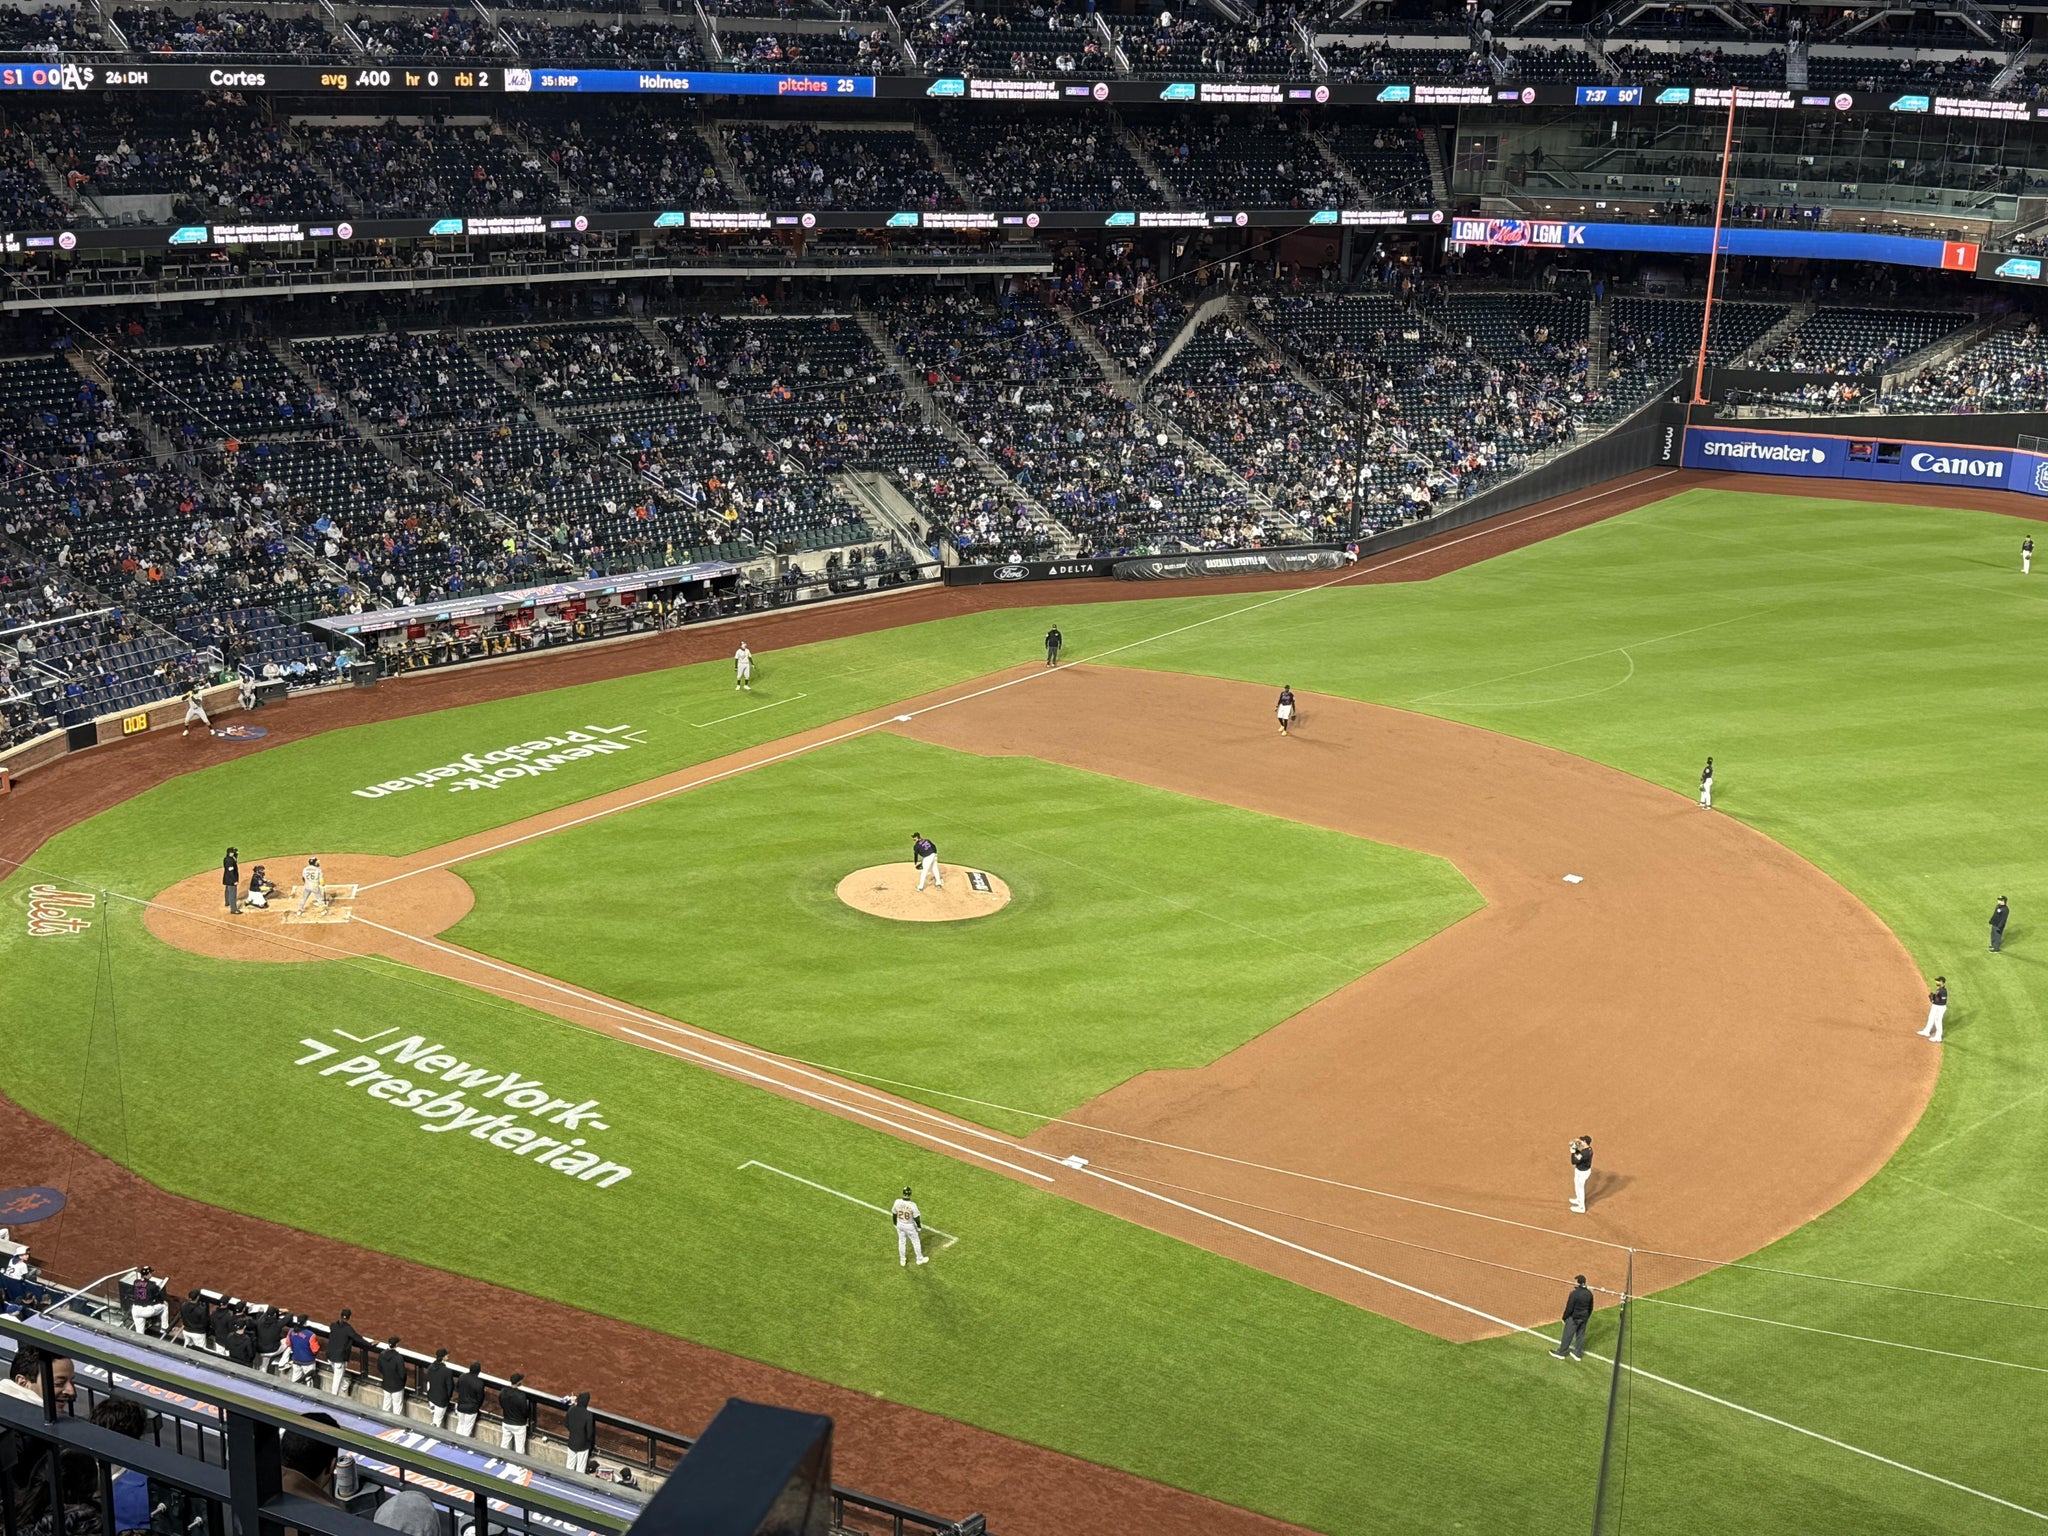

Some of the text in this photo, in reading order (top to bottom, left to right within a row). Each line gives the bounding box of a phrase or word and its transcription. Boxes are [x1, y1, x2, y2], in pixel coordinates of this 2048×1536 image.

[209, 70, 266, 86] Cortes
[321, 72, 347, 90] avg
[355, 70, 391, 87] .400
[405, 71, 420, 86] hr
[427, 71, 439, 86] 0
[454, 72, 473, 87] rbi
[478, 72, 489, 87] 2
[639, 74, 690, 90] Holmes
[778, 78, 828, 94] pitches
[837, 79, 855, 93] 25
[1585, 89, 1638, 103] 7:37 50°
[1455, 221, 1485, 240] LGM
[1491, 225, 1522, 242] Mets
[1533, 224, 1587, 244] LGM K
[1956, 247, 1966, 266] 1
[1661, 427, 1674, 460] 335
[1703, 441, 1811, 463] smartwater
[1910, 452, 2004, 478] Canon
[1000, 567, 1023, 579] Ford
[1060, 564, 1094, 574] DELTA
[123, 714, 148, 734] 008
[351, 730, 598, 798] Presbyterian
[28, 884, 95, 937] Mets
[318, 1055, 633, 1189] Presbyterian
[898, 1210, 911, 1221] 28
